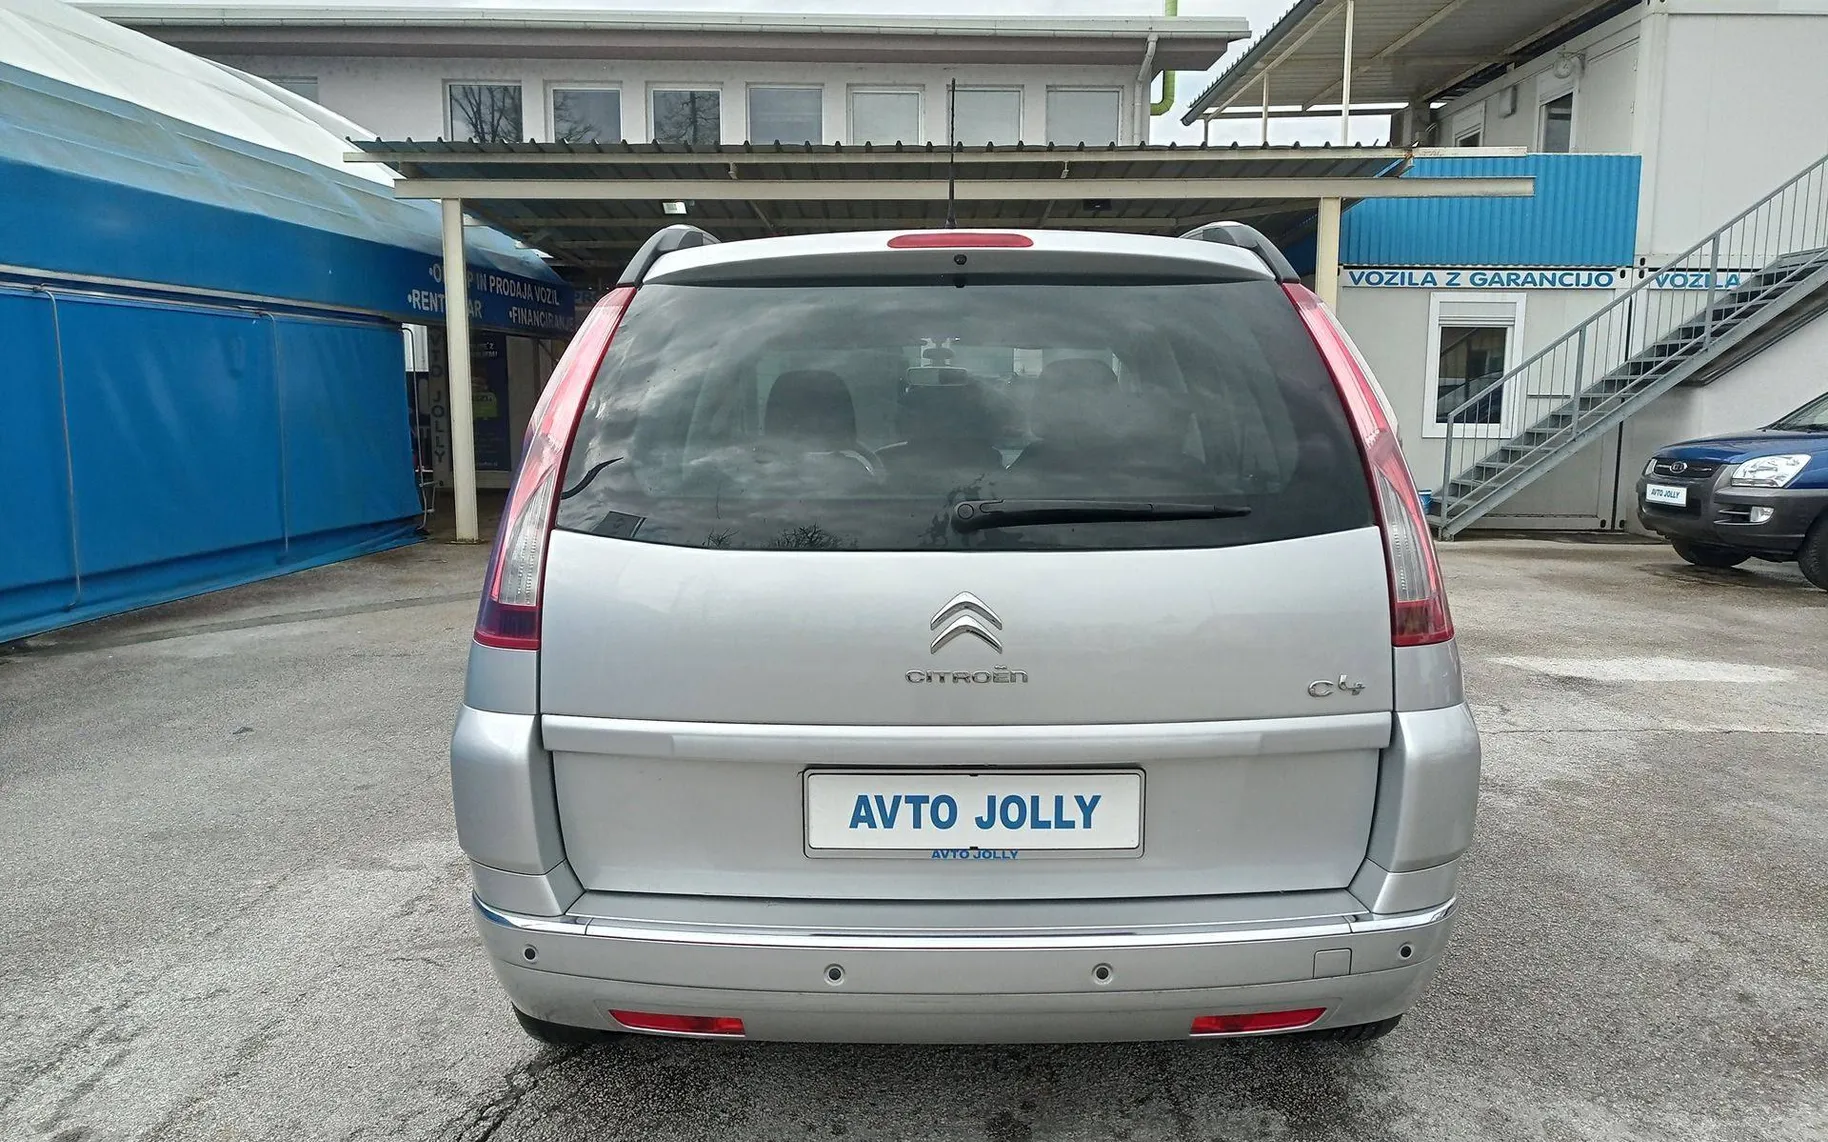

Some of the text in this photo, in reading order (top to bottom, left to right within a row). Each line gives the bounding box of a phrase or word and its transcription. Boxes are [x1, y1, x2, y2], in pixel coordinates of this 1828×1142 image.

[476, 272, 488, 292] IN
[489, 275, 533, 301] PRODAJA
[534, 286, 560, 306] VOZIL
[1349, 270, 1614, 288] VOZILA Z GARANCIJO
[412, 289, 482, 319] RENT AR
[429, 330, 446, 462] VTO JOLLY
[1651, 488, 1680, 499] AVTO JOLLY
[905, 665, 1028, 684] CITROËN
[1308, 674, 1366, 698] C4
[849, 795, 1102, 829] AVTO JOLLY
[931, 849, 1018, 859] AVTO JOLLY
